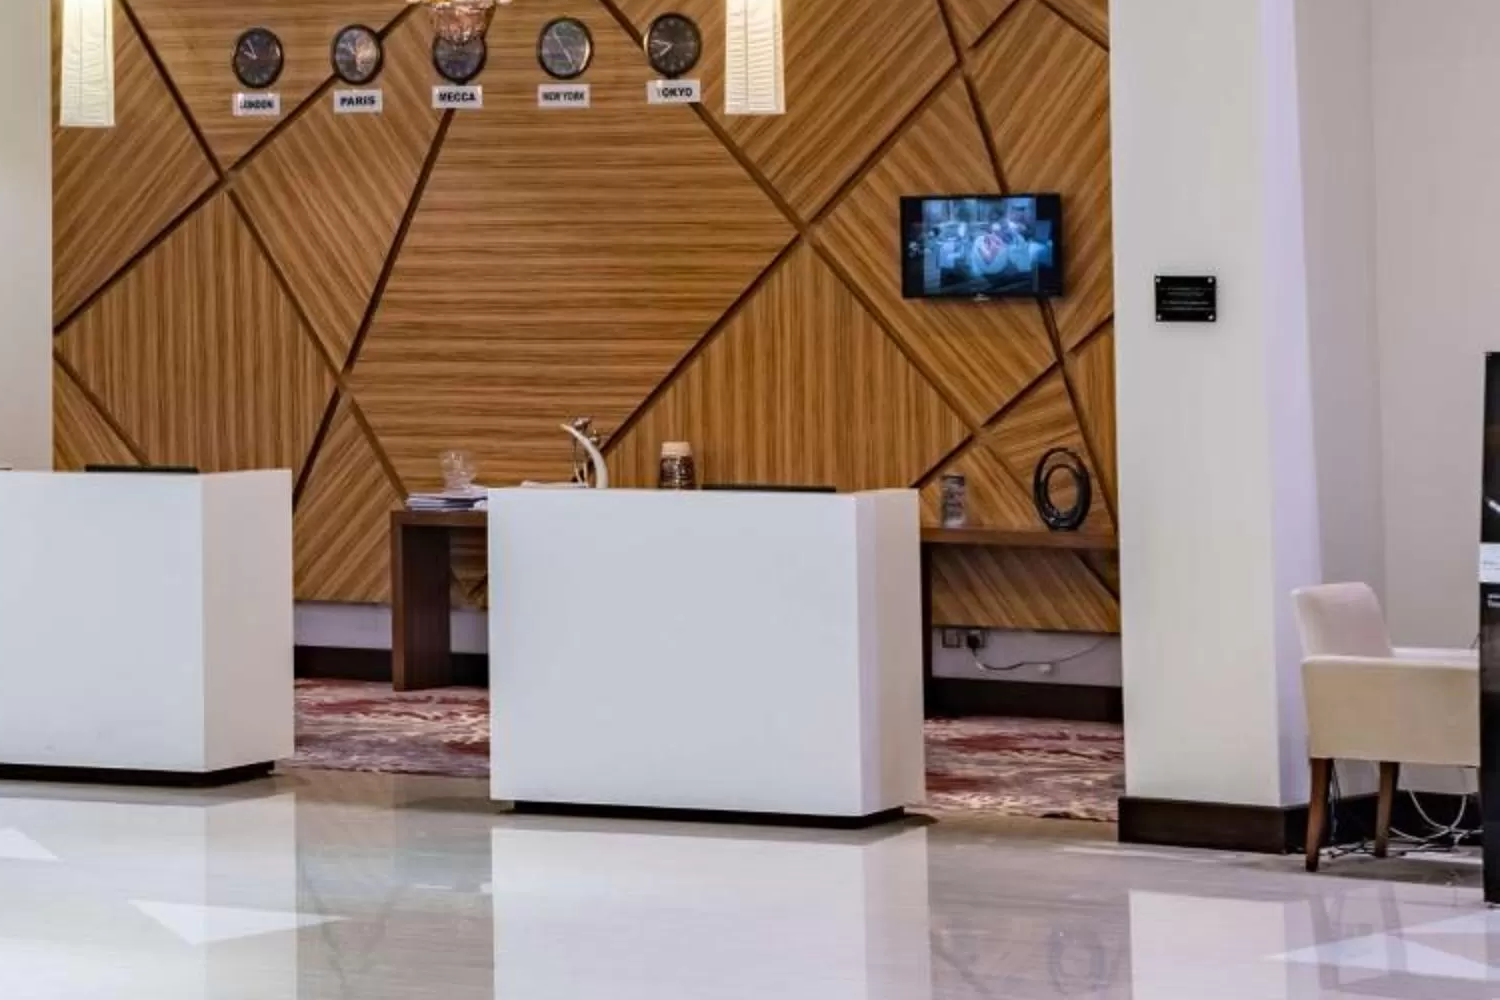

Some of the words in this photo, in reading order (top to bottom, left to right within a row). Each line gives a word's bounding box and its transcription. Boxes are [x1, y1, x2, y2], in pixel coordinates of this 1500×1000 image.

[438, 91, 476, 102] MECCA
[542, 91, 560, 101] NEW
[563, 91, 585, 101] YORK
[656, 87, 693, 98] TOKYO
[240, 99, 274, 109] LONDON
[340, 95, 376, 106] PARIS
